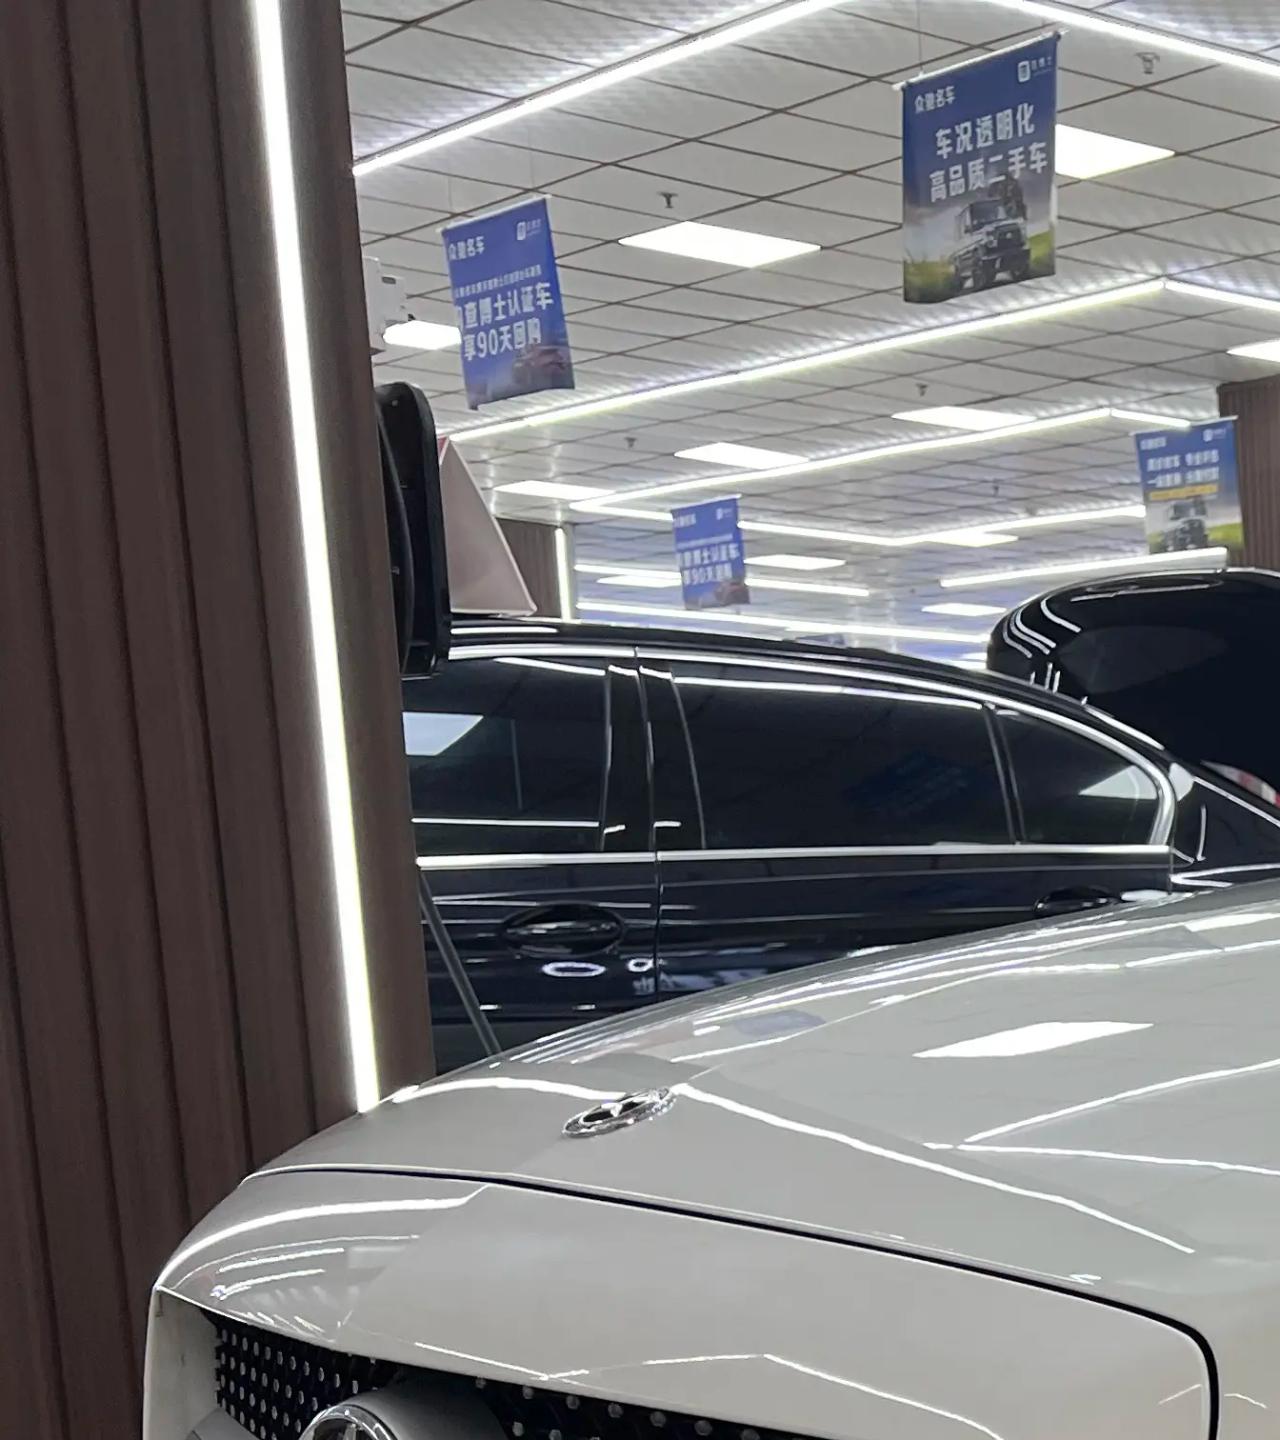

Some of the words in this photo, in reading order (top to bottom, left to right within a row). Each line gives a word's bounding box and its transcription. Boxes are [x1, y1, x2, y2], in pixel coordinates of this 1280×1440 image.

[935, 102, 1036, 160] 车况透明化
[929, 141, 1049, 203] 高品质二手车
